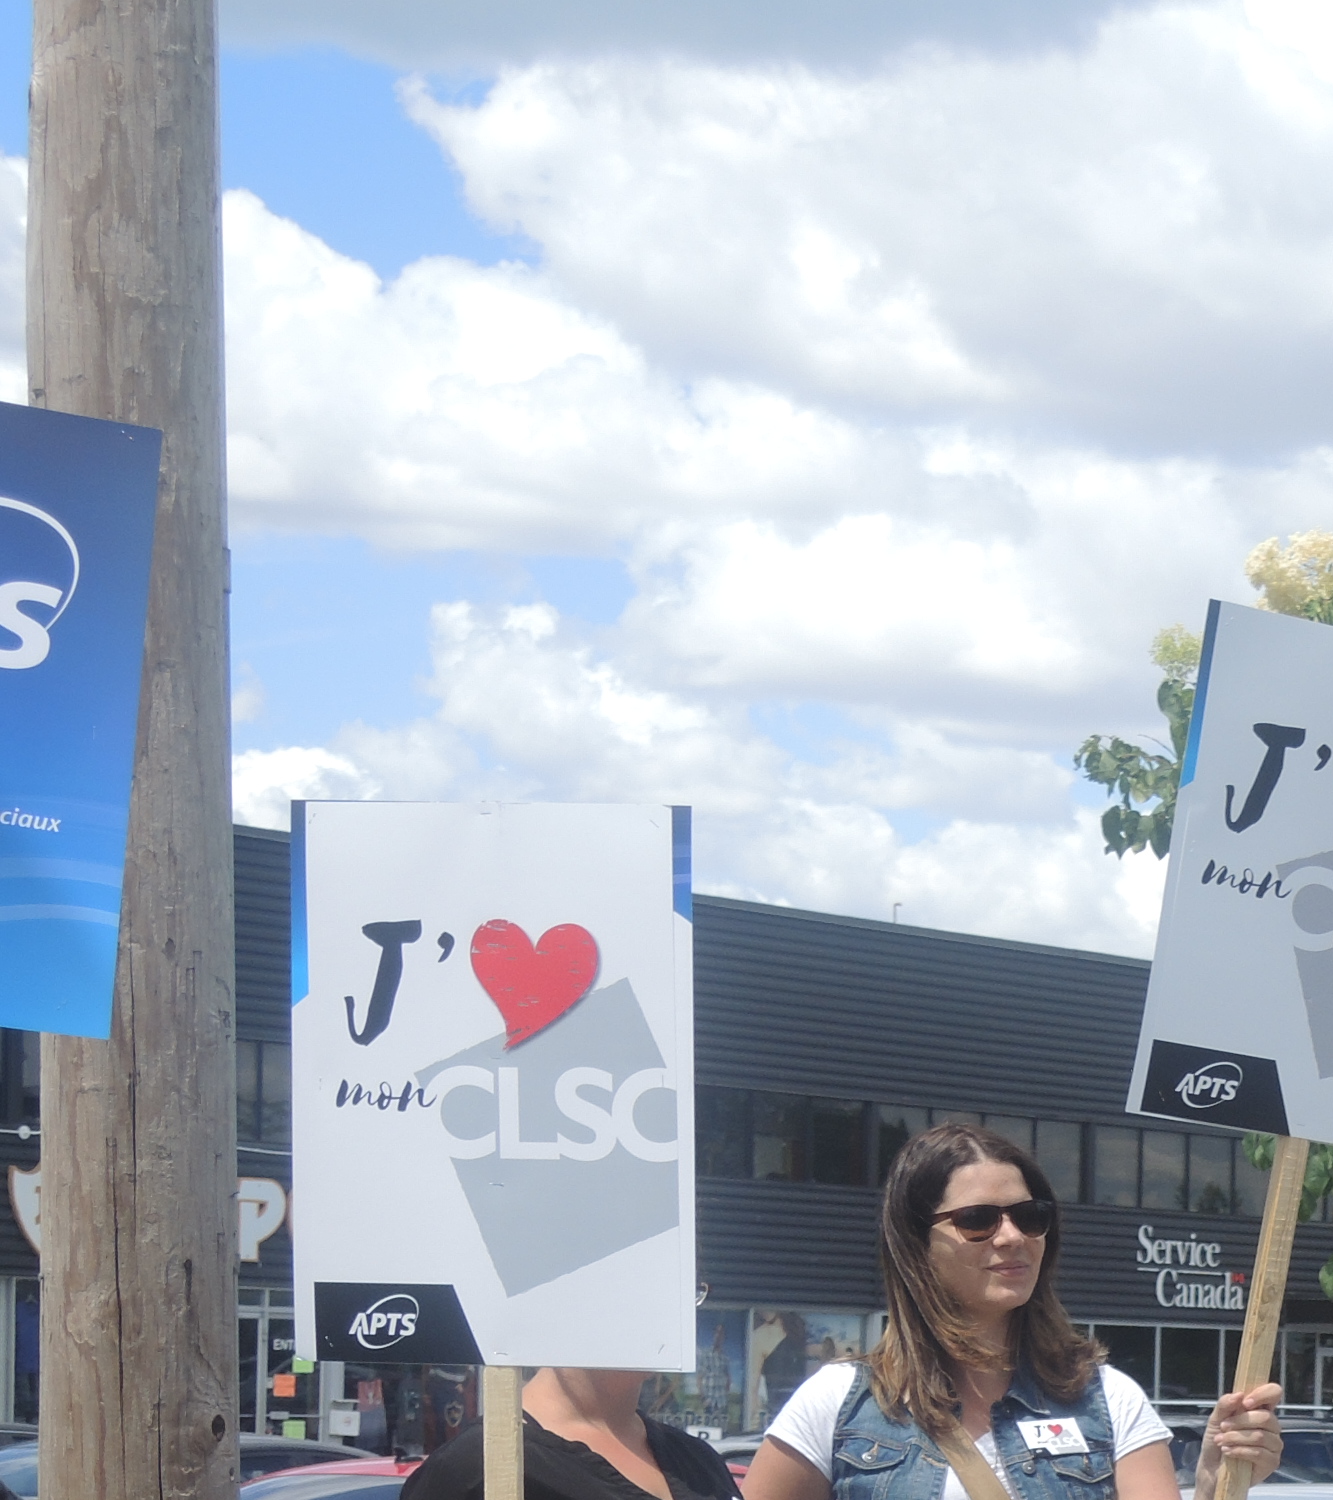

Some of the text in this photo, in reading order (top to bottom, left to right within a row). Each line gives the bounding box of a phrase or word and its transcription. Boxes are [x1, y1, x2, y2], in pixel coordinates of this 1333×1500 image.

[0, 807, 61, 833] ciaux
[1201, 859, 1293, 900] mon
[335, 1078, 438, 1113] mon
[1175, 1072, 1240, 1102] APTS
[424, 1064, 680, 1163] CLSC
[1136, 1224, 1221, 1268] Service
[1155, 1268, 1245, 1310] Canada
[348, 1310, 419, 1339] APTS
